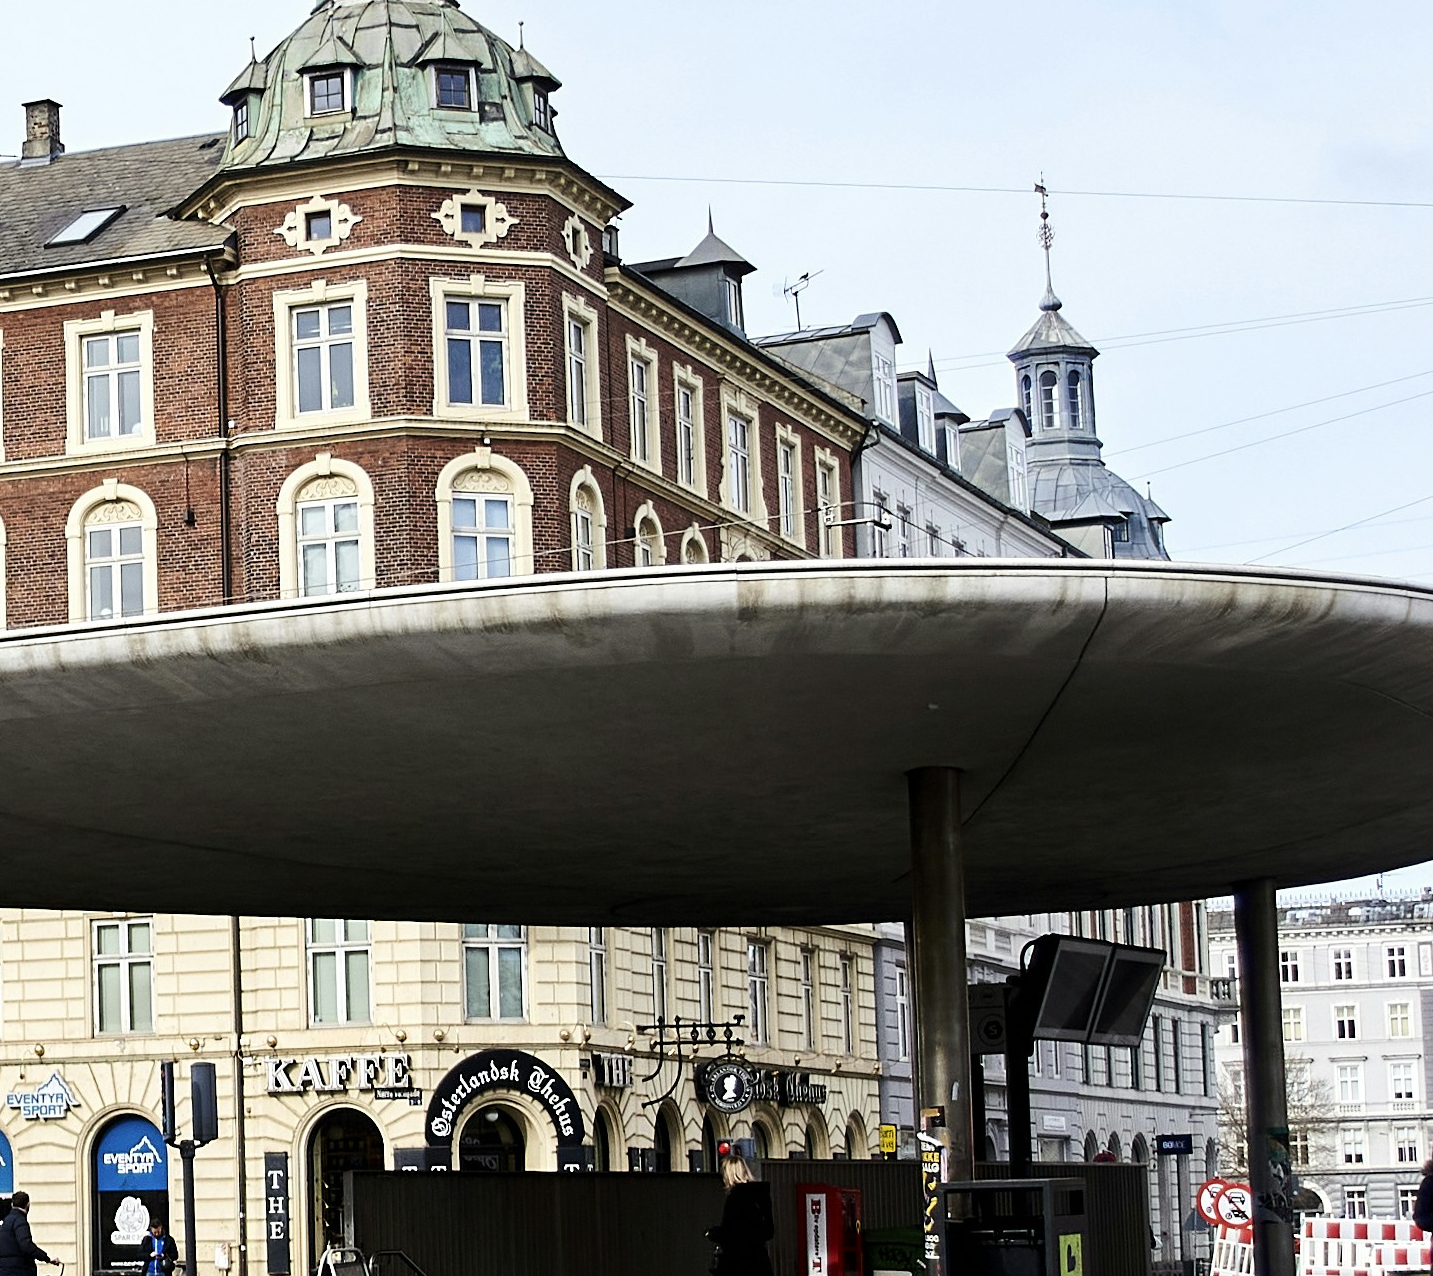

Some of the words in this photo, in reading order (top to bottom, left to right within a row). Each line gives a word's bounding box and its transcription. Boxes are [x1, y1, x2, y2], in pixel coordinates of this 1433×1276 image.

[264, 1054, 409, 1092] KAFFE
[6, 1093, 64, 1105] EVENTYR
[527, 1065, 574, 1137] Thehus
[22, 1105, 65, 1117] SPORT
[103, 1153, 155, 1164] EVENTYR
[117, 1163, 154, 1174] SPORT
[267, 1170, 285, 1239] THE
